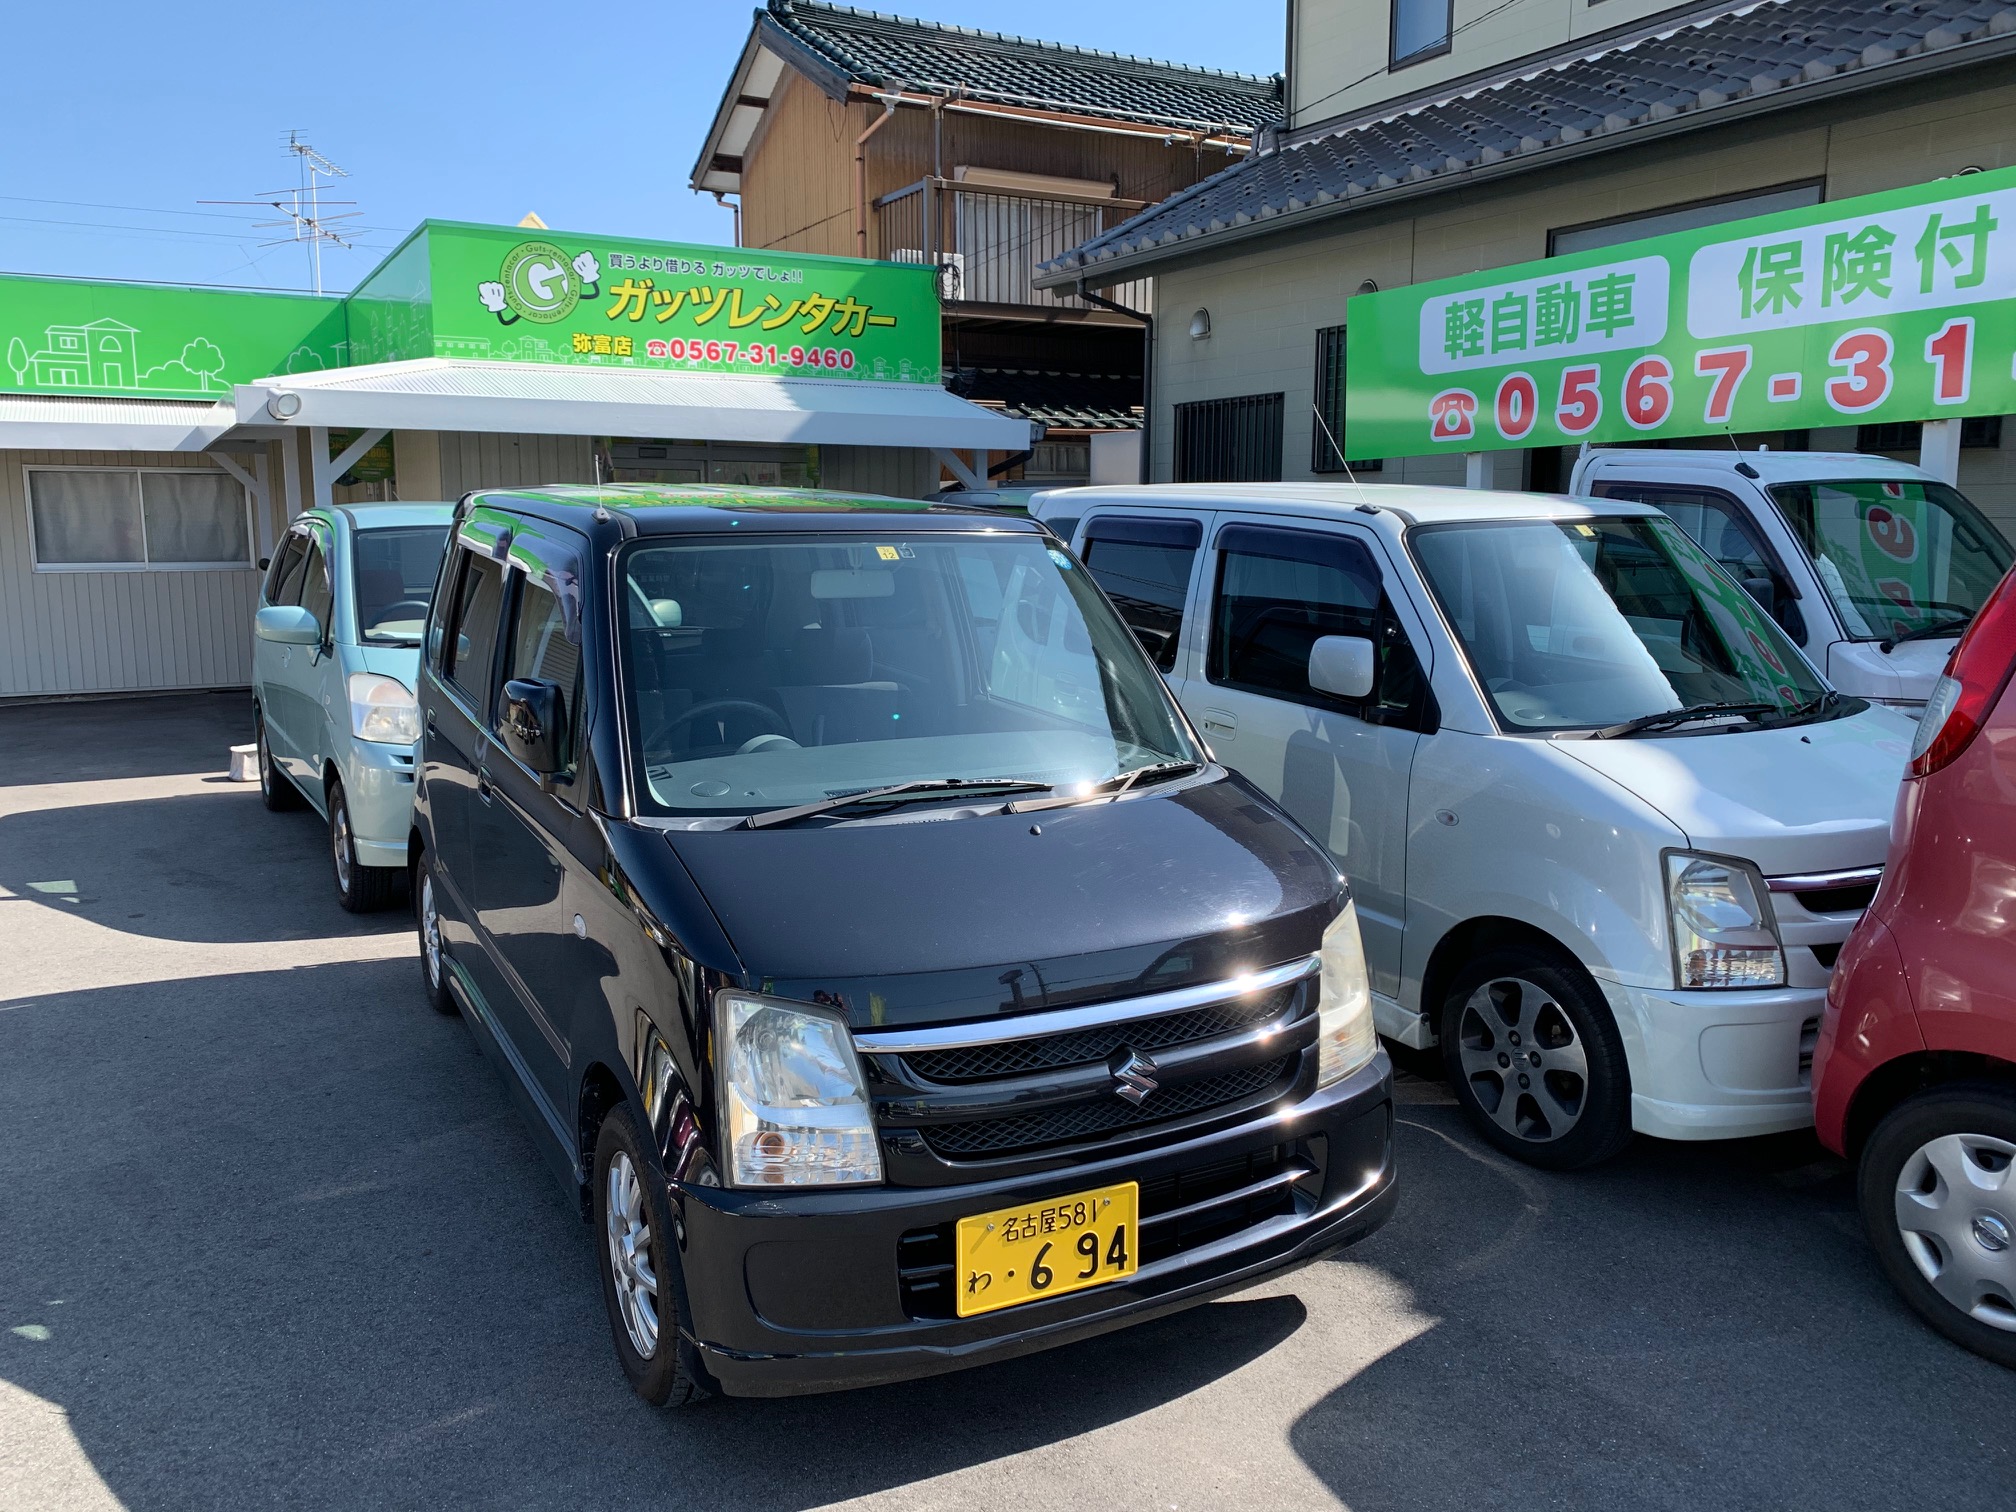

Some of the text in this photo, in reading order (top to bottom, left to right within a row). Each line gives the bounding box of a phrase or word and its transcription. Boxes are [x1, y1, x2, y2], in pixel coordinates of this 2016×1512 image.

[609, 253, 706, 275] 買うより借りる
[1737, 203, 1999, 320] 保険付
[605, 278, 897, 338] ガッツレンタカー
[1443, 272, 1637, 360] 軽自動車
[572, 332, 633, 357] 弥富店
[671, 338, 855, 369] 0567-31-9460
[1497, 322, 2016, 436] 0567-31
